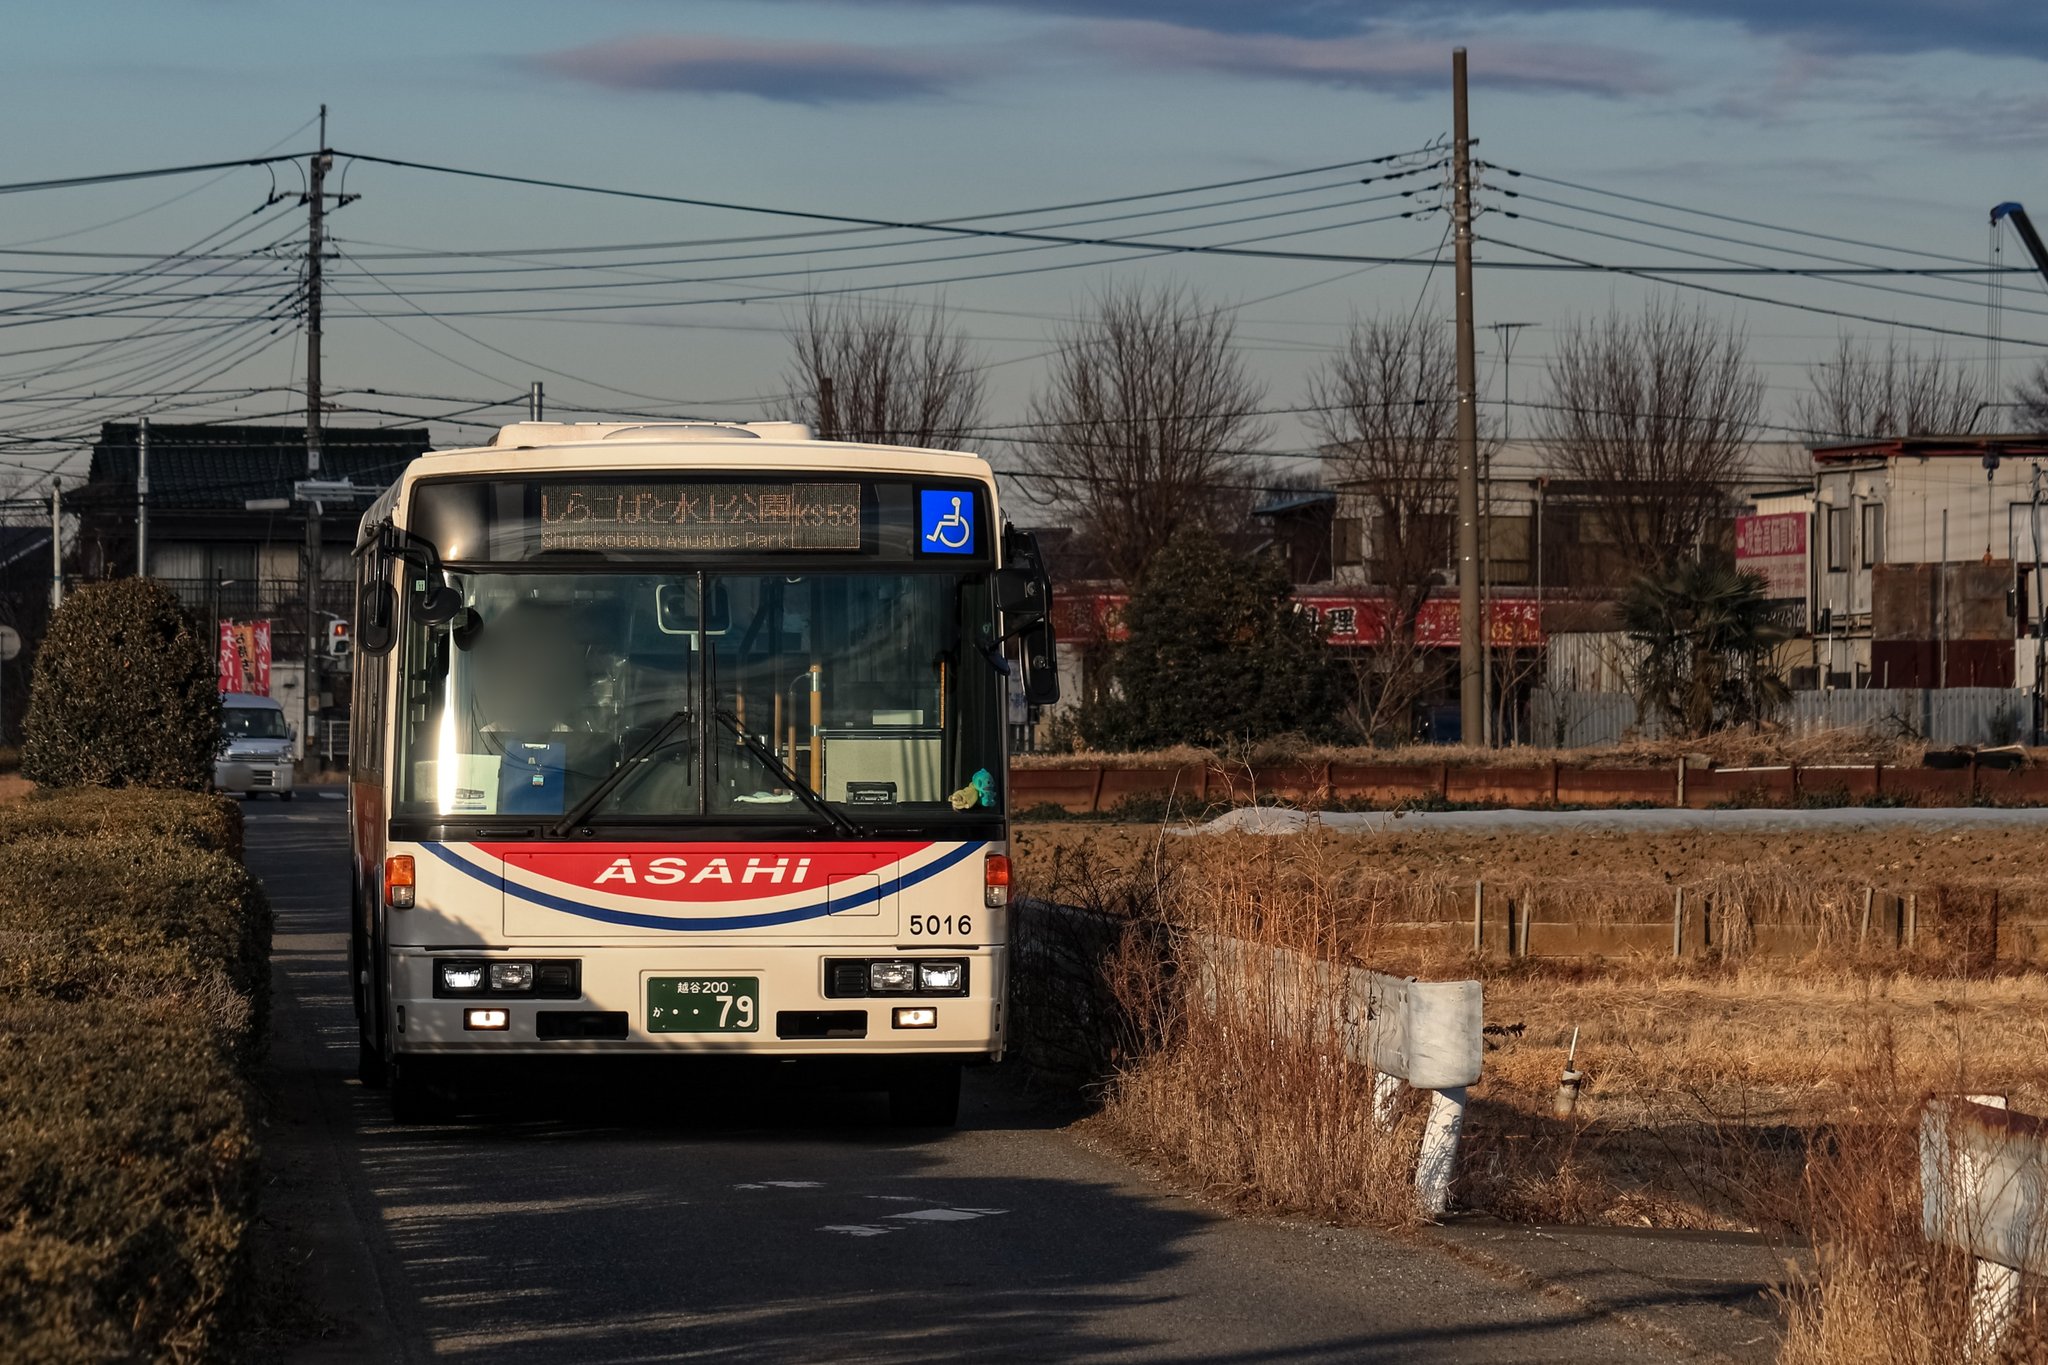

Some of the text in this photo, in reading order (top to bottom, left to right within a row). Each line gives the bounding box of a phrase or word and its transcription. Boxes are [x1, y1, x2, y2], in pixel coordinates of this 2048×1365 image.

[542, 491, 857, 527] しらこばと水上公園 KS53
[542, 529, 789, 548] Shirakobato Aquatic Park
[592, 857, 812, 885] ASAHI
[908, 914, 973, 936] 5016
